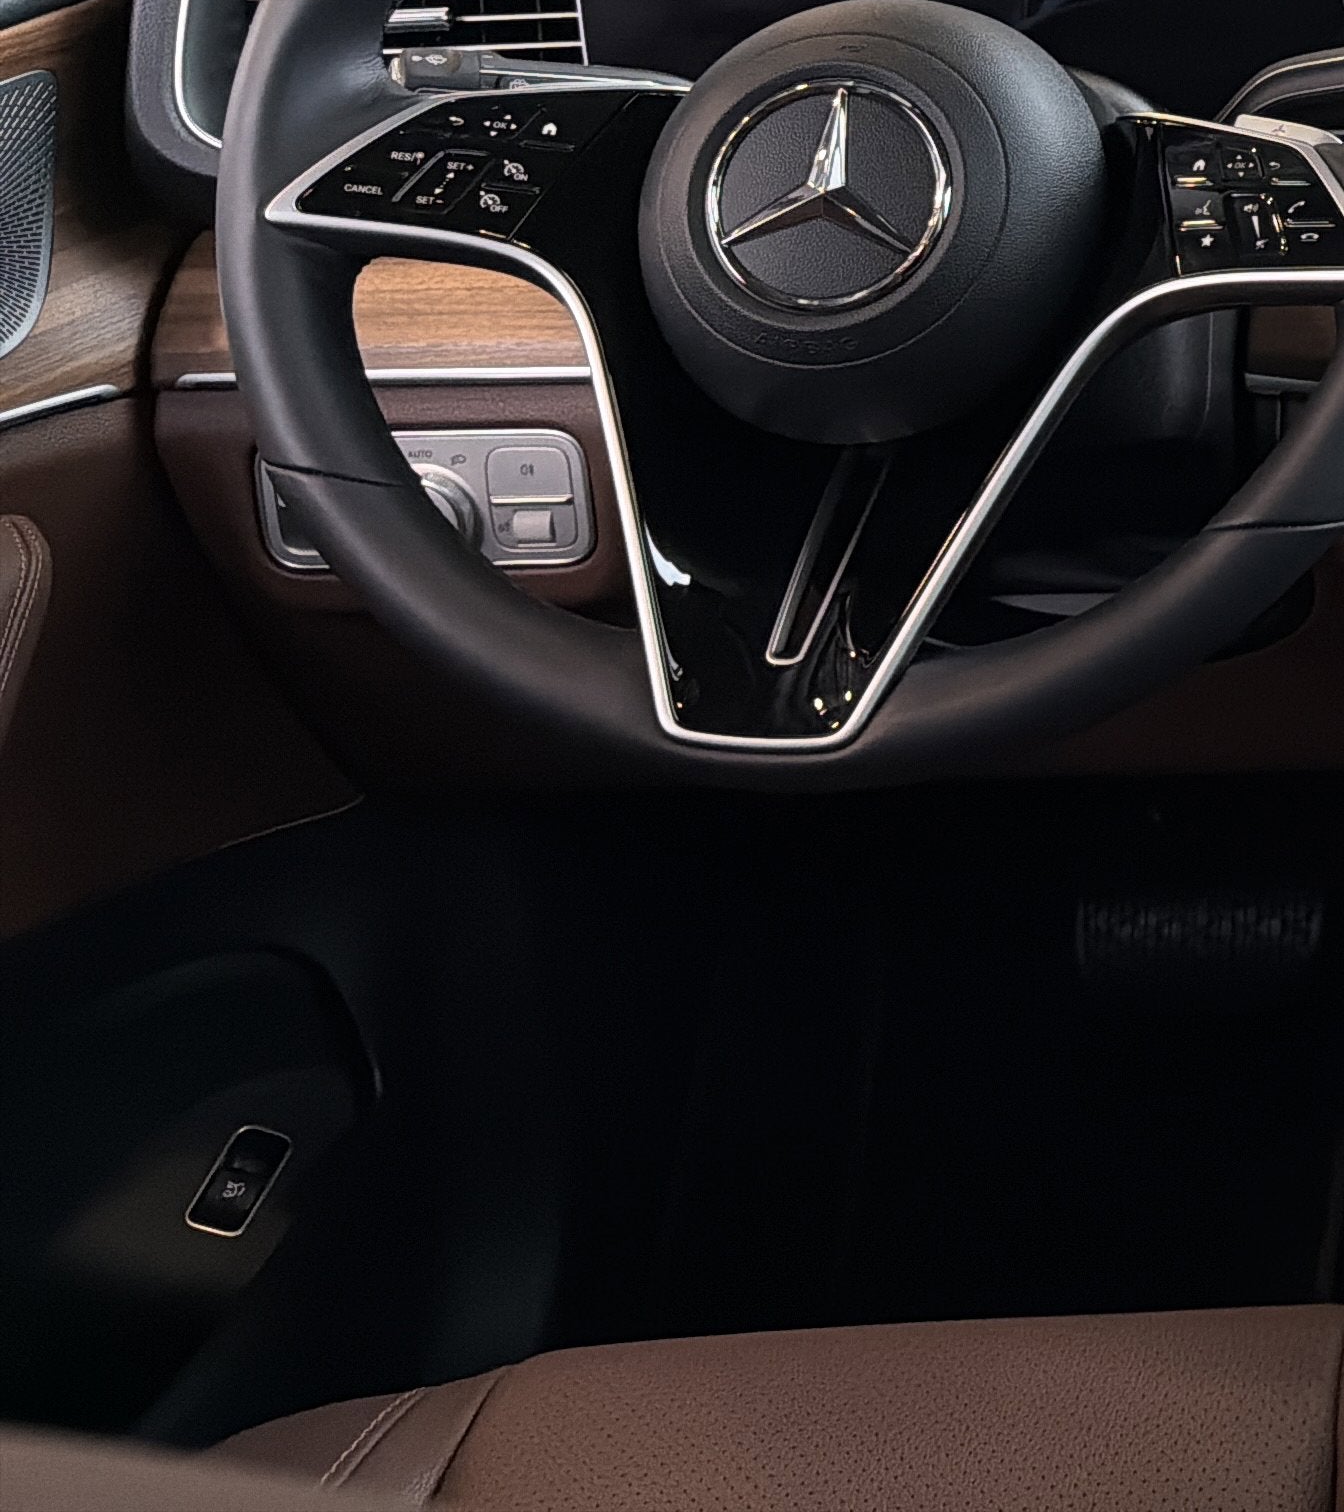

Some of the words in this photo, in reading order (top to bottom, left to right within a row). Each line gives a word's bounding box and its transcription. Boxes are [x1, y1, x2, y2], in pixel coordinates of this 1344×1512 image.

[492, 121, 508, 130] OK
[1234, 161, 1247, 170] OK
[513, 173, 529, 182] ON
[344, 183, 384, 196] CANCEL
[489, 204, 509, 214] OFF
[408, 449, 433, 459] AUTO
